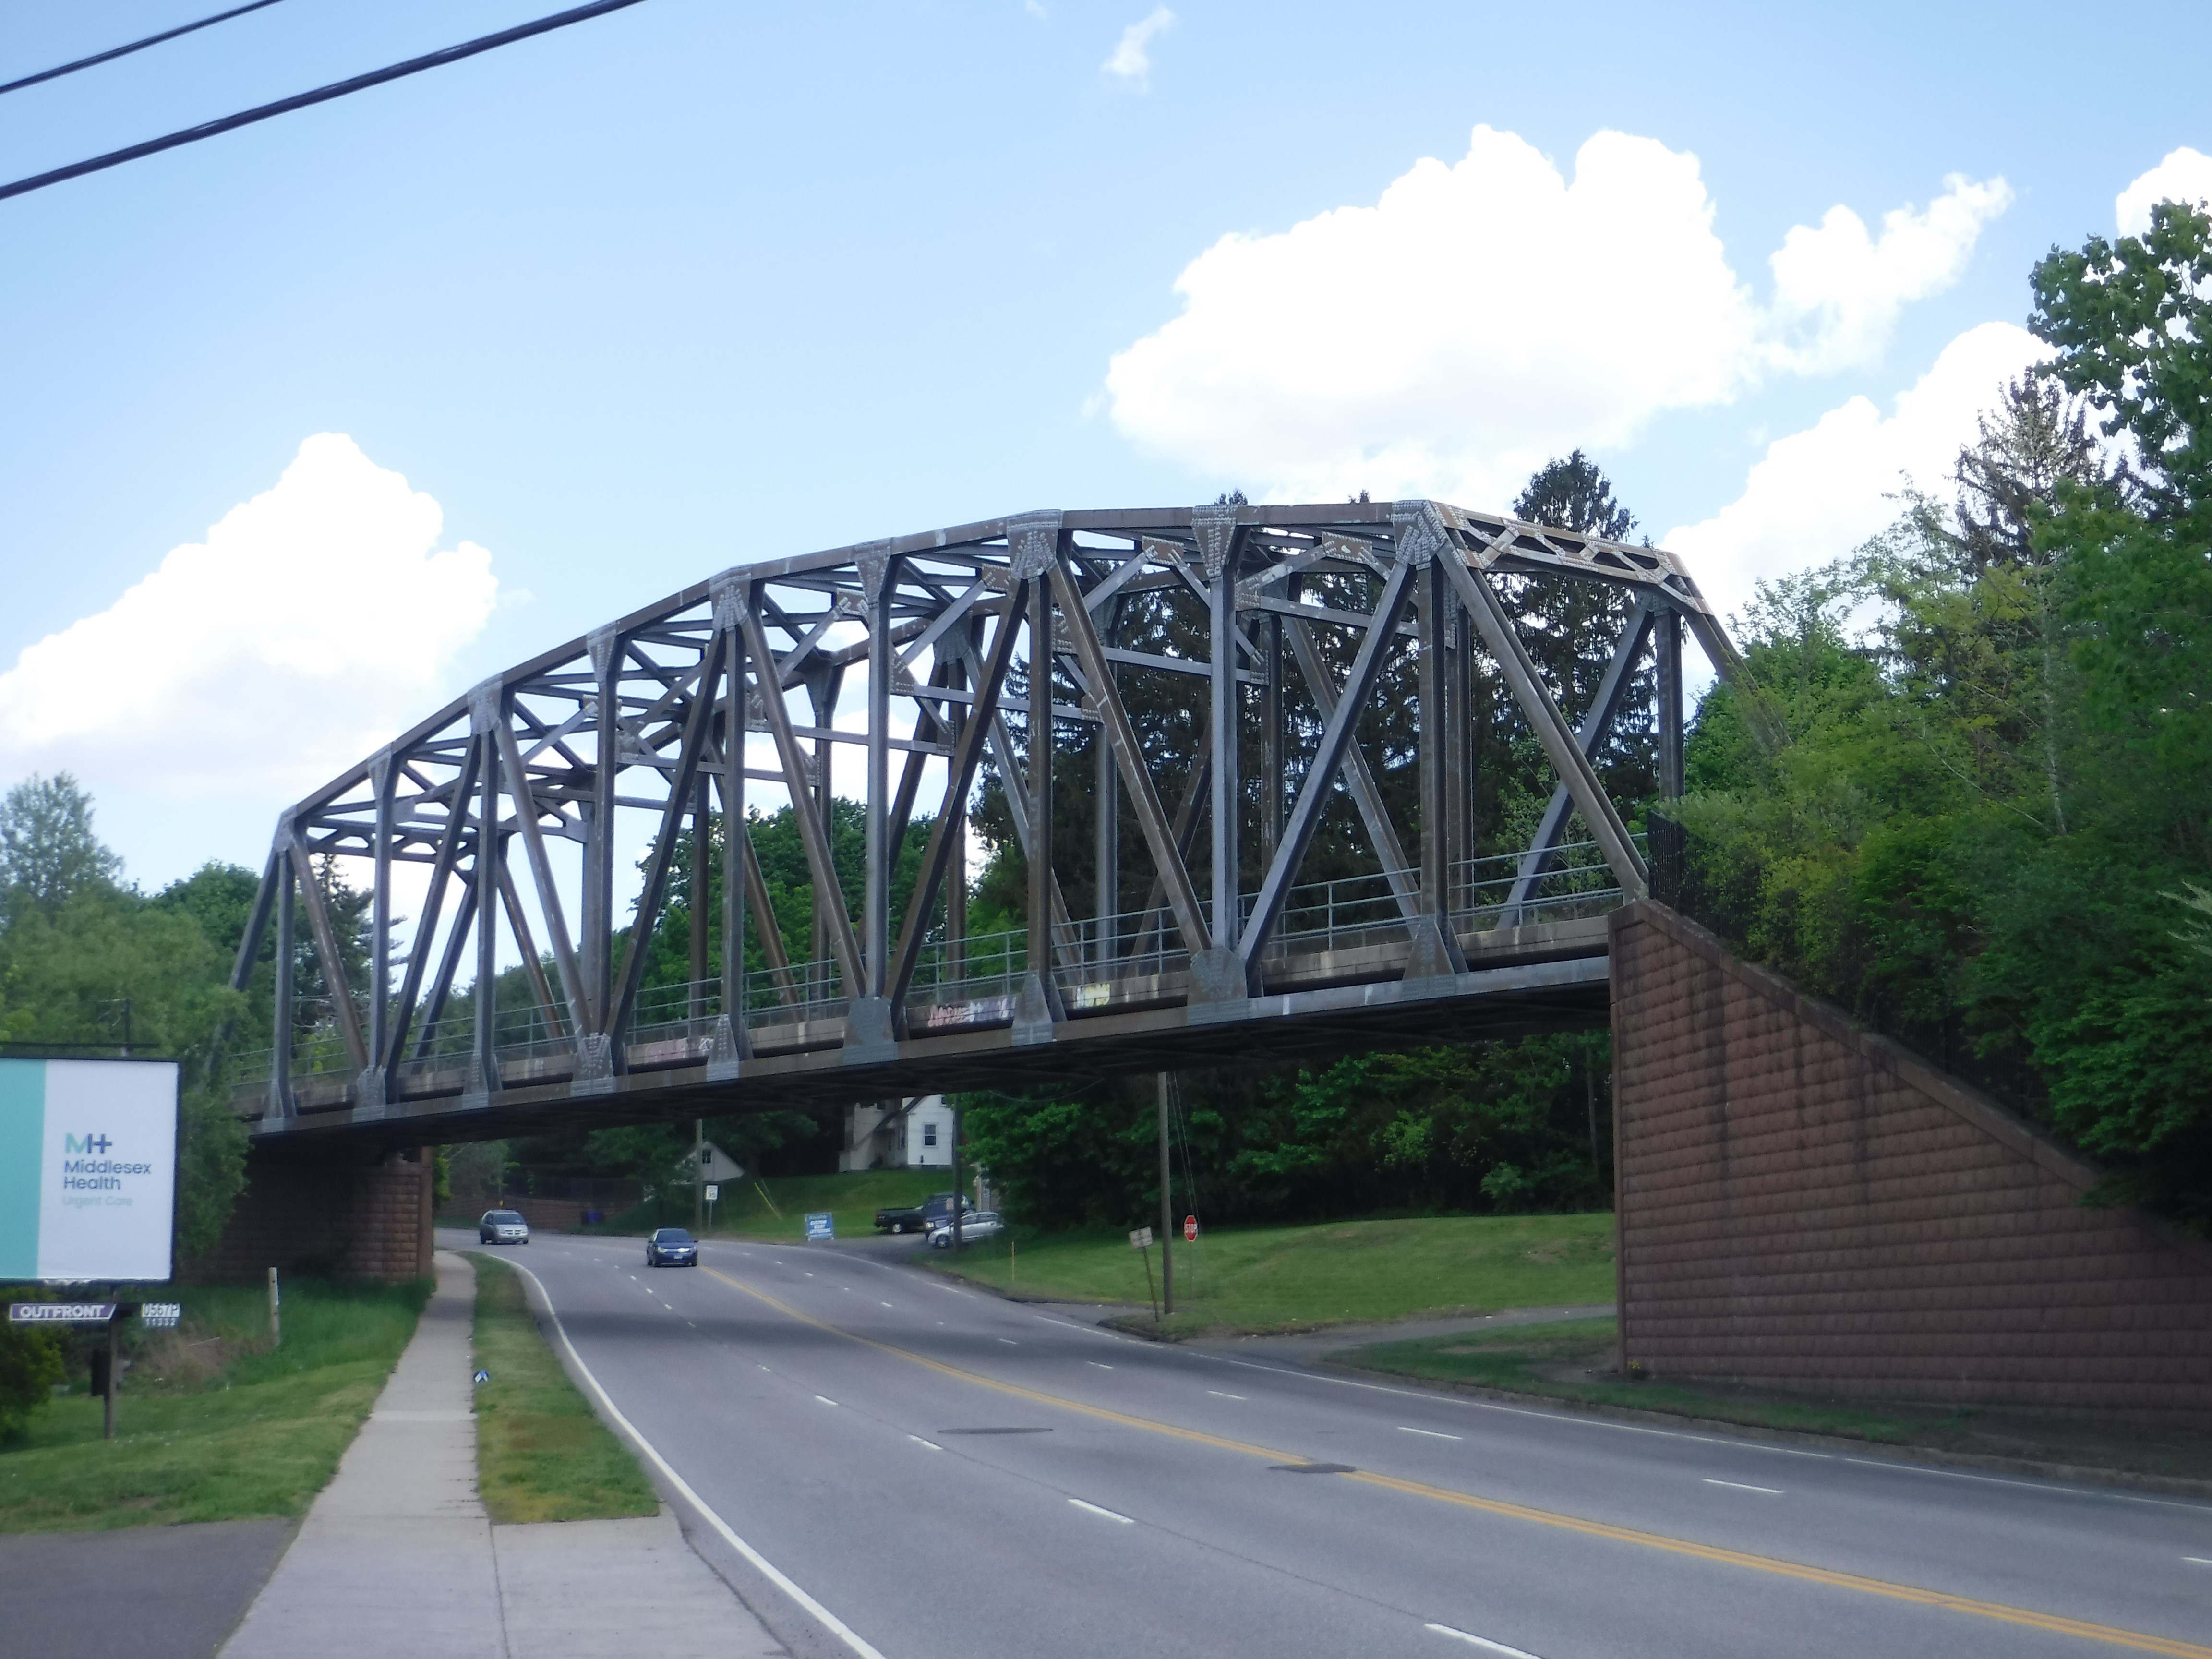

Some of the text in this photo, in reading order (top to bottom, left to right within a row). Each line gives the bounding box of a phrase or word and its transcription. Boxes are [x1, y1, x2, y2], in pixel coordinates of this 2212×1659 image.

[64, 1159, 152, 1174] Middlesex
[64, 1176, 121, 1190] Health
[63, 1196, 133, 1209] Urgent Care
[1185, 1223, 1197, 1233] STOP
[20, 1305, 105, 1318] OUTFRONT
